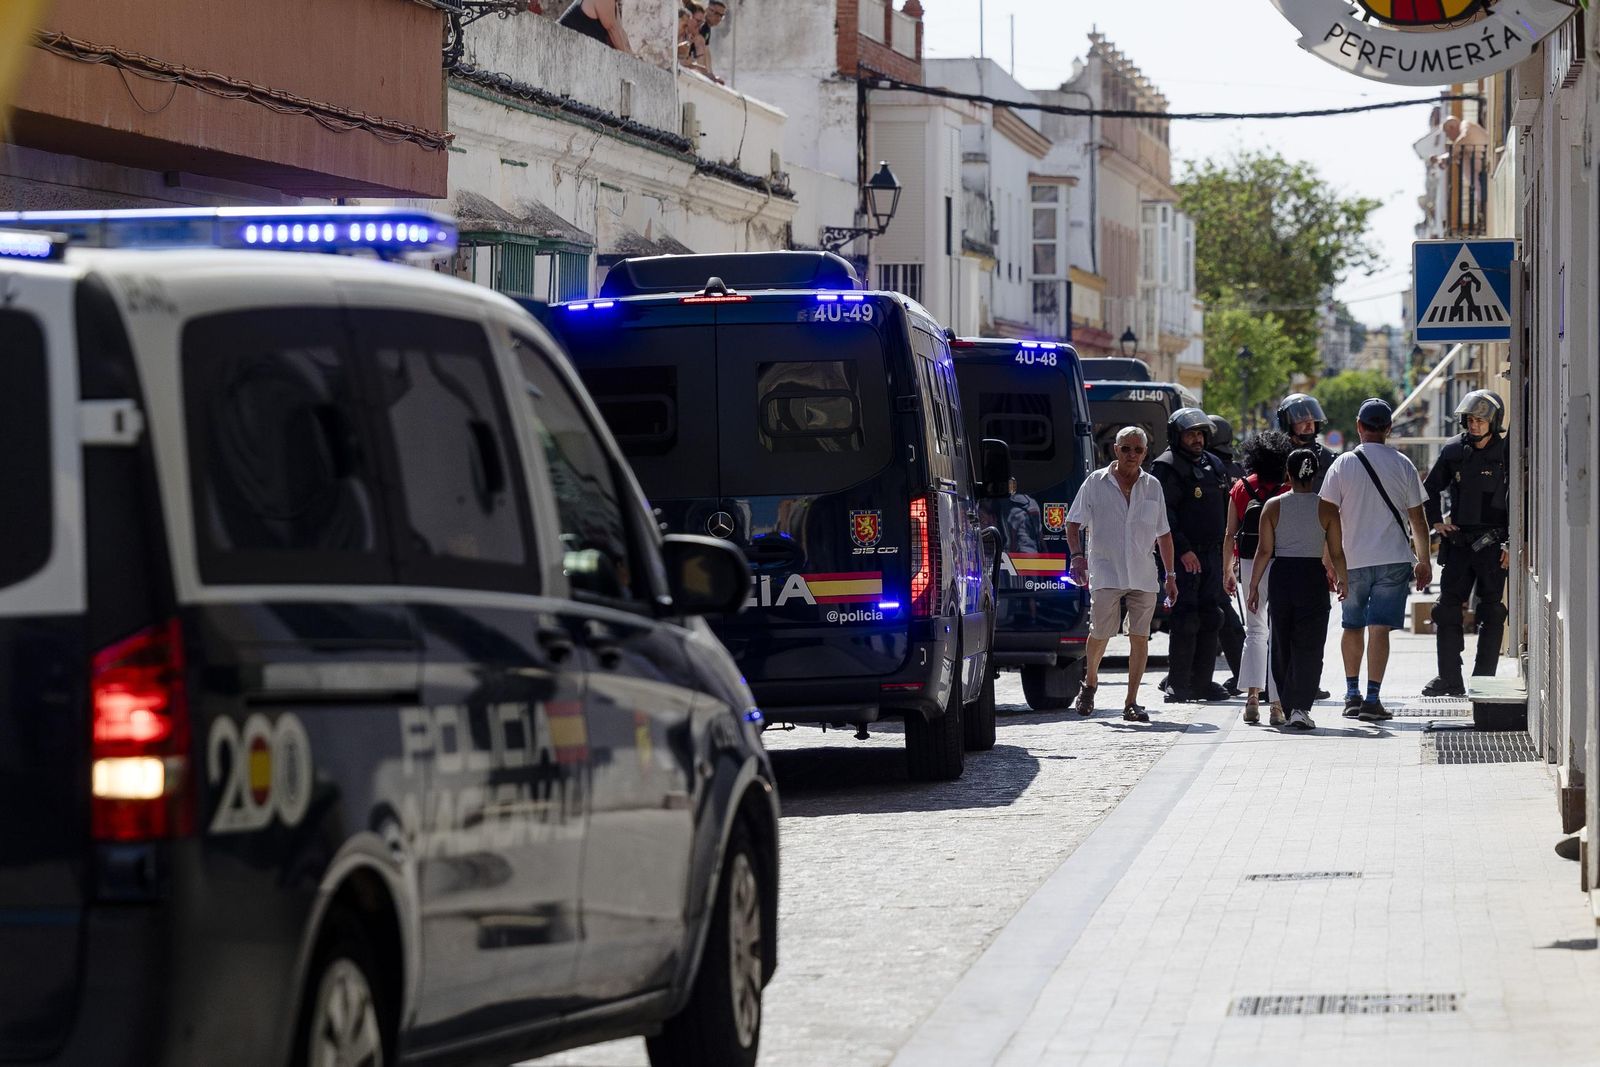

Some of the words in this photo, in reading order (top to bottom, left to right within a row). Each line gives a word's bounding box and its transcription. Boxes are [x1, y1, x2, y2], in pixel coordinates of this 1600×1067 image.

[1323, 22, 1522, 73] PERFUMERÍA
[814, 303, 873, 322] 4U-49
[1015, 350, 1057, 366] 4U-48
[1128, 389, 1164, 402] 4U-40
[1024, 580, 1066, 591] @policia
[826, 609, 883, 624] @policia
[207, 712, 312, 834] 200
